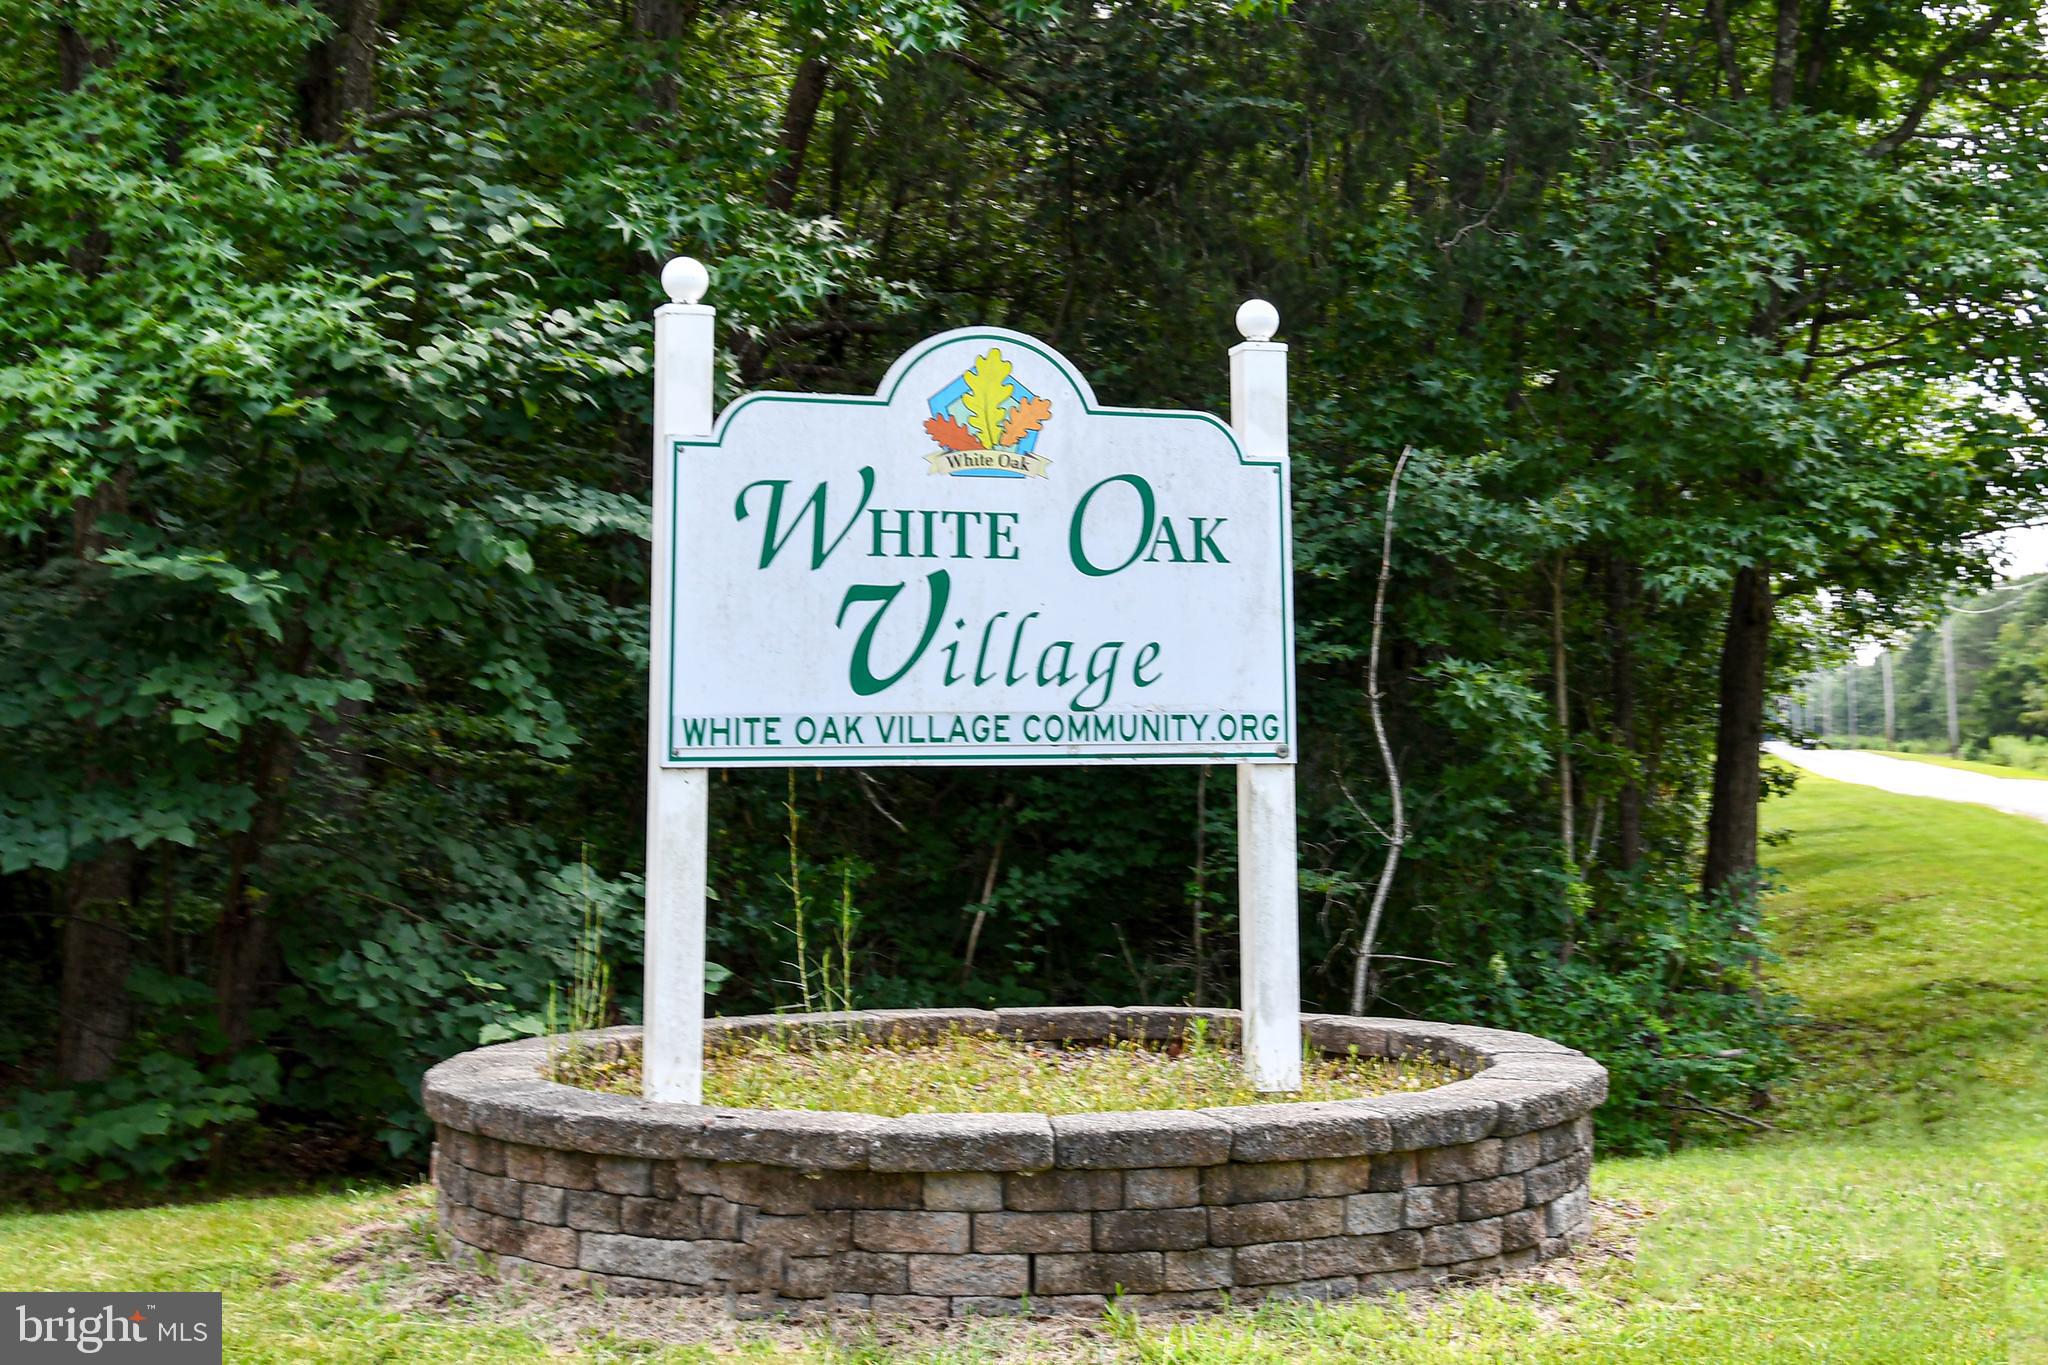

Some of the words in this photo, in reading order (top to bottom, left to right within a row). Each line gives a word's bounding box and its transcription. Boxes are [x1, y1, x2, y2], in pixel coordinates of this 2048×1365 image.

[947, 453, 994, 469] White
[998, 454, 1030, 471] Oak
[835, 568, 1163, 713] Village
[682, 716, 782, 747] WHITE
[794, 715, 865, 746] OAK
[875, 714, 1010, 745] VILLAGE
[1022, 713, 1280, 743] COMMUNITY.ORG
